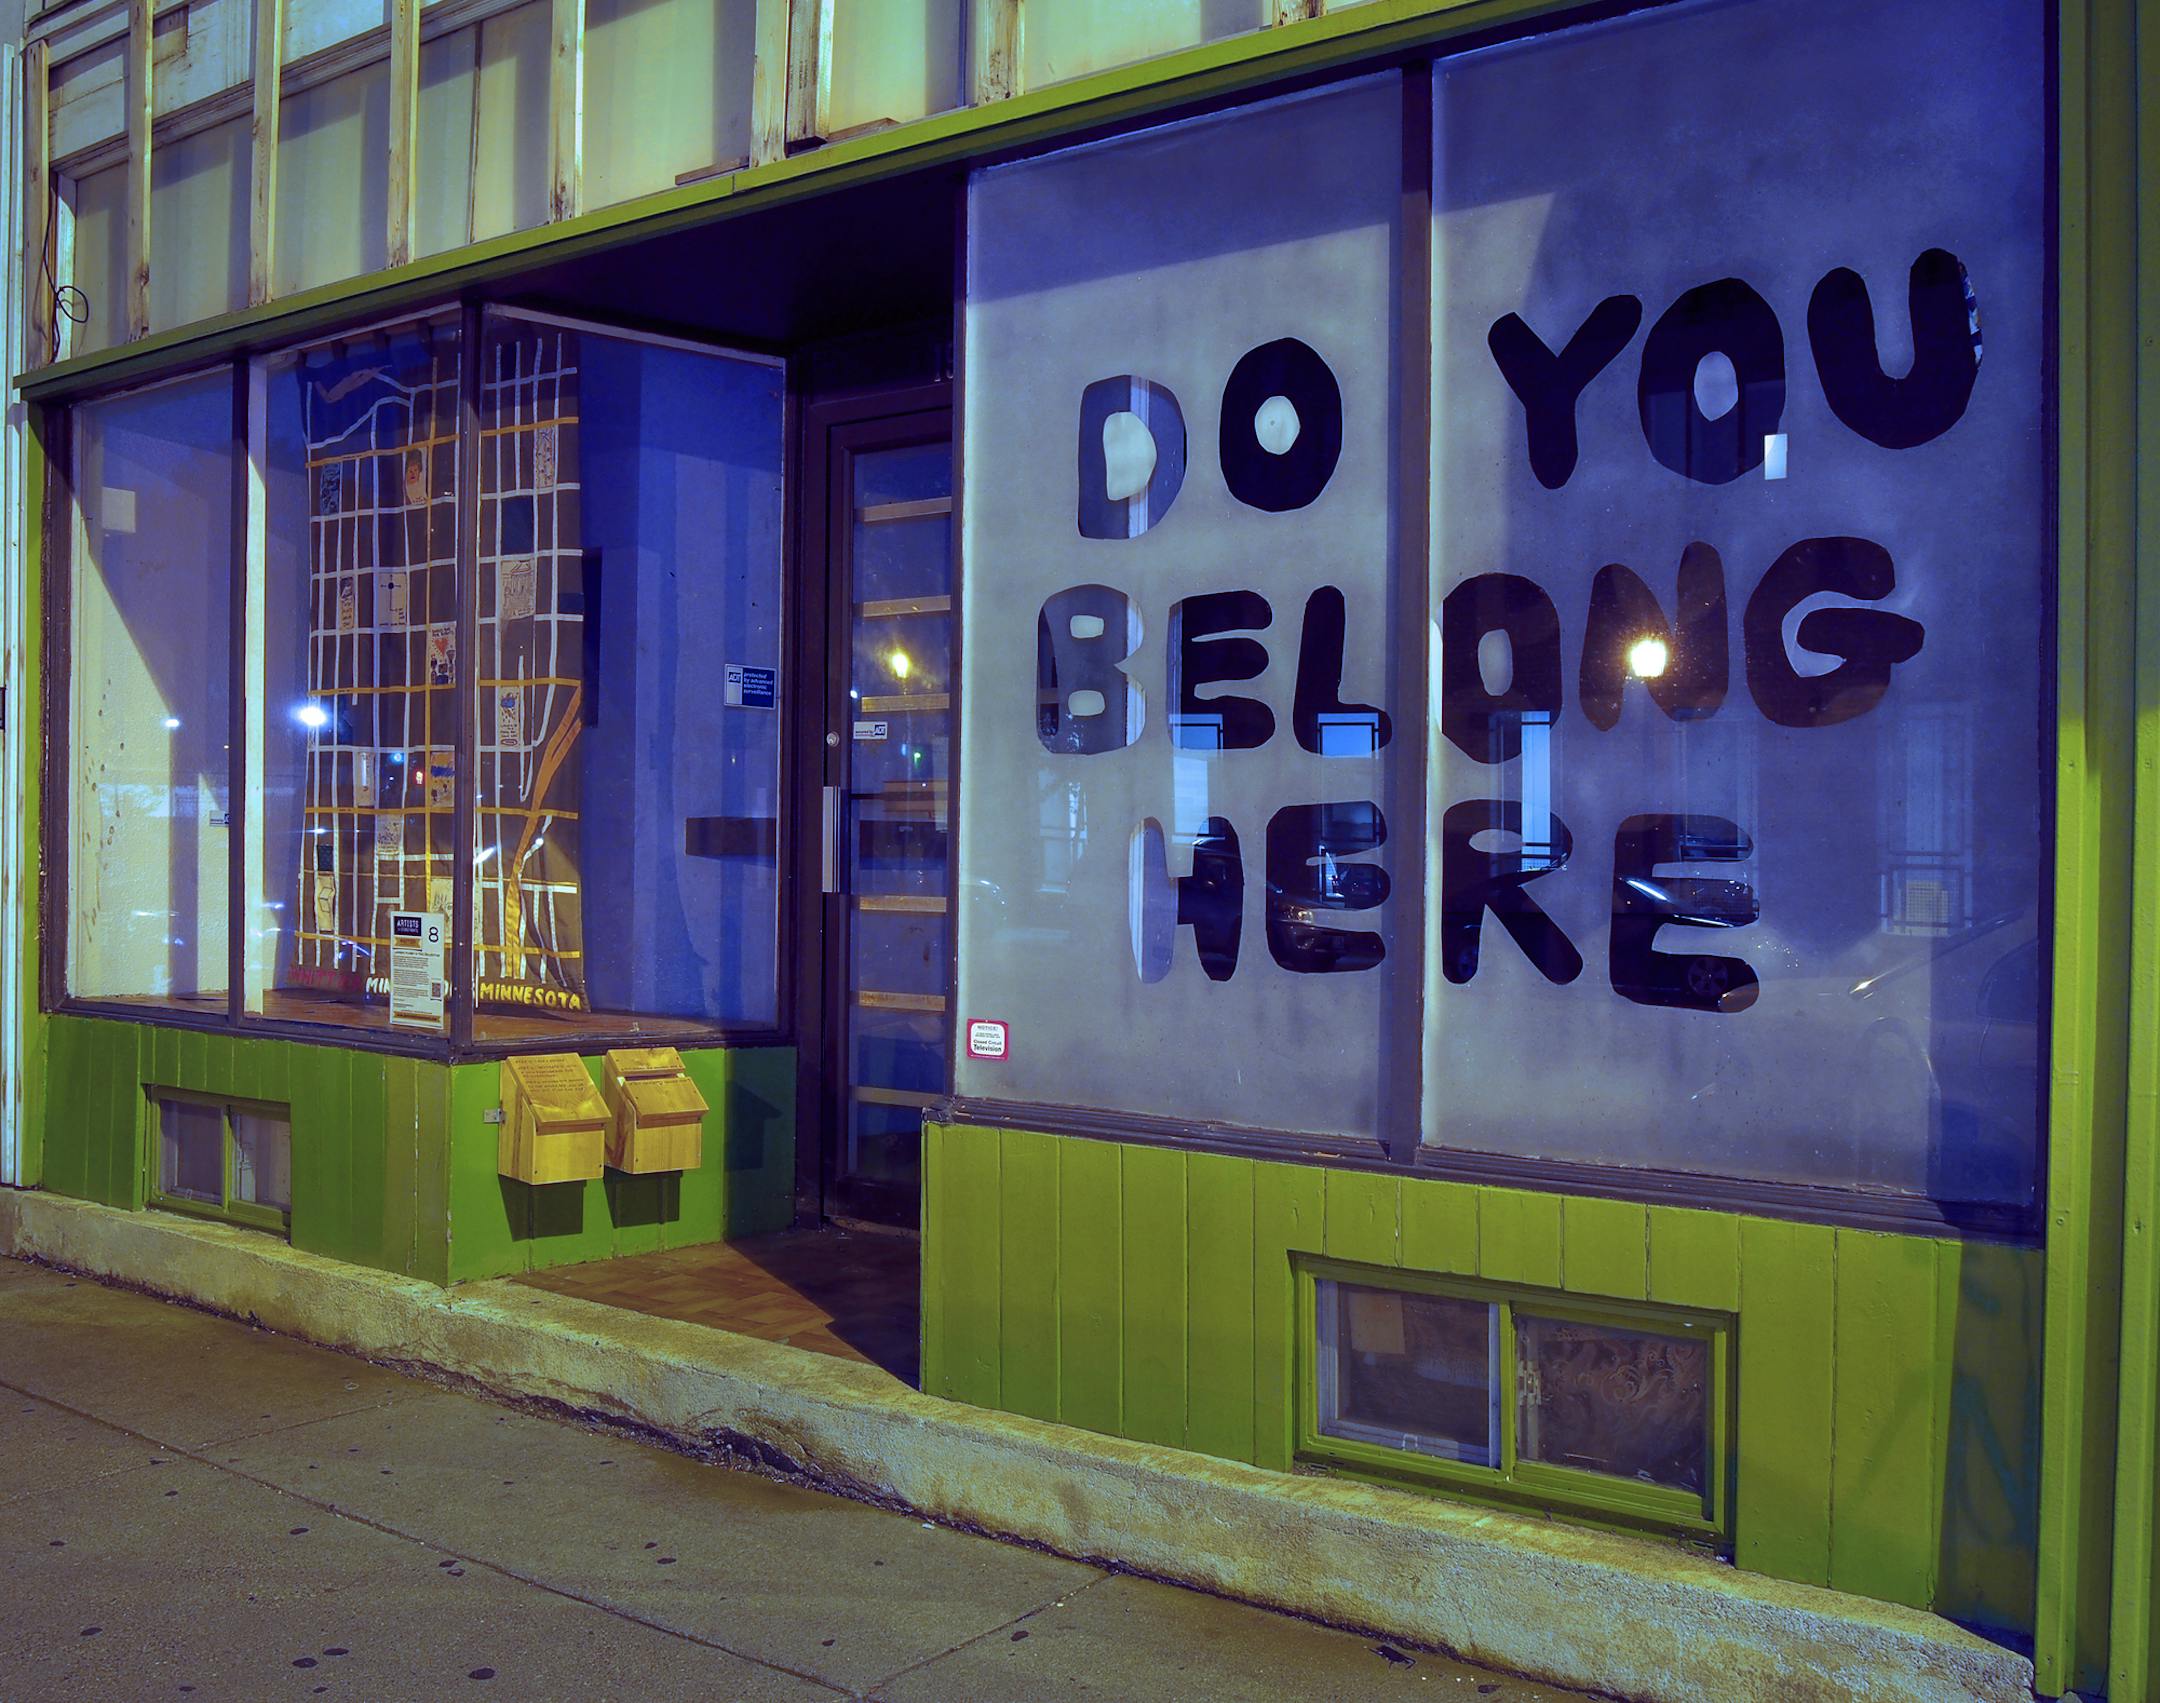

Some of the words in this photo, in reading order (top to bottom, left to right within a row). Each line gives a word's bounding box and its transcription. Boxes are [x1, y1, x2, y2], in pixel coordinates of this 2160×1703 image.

[1078, 338, 1342, 539] DO
[1487, 248, 1983, 489] YOU
[1036, 536, 1925, 763] BELONG
[397, 919, 419, 929] ARTISTS
[429, 926, 439, 943] 8
[1128, 800, 1760, 1012] HERE
[479, 982, 582, 1010] MINNESOTA
